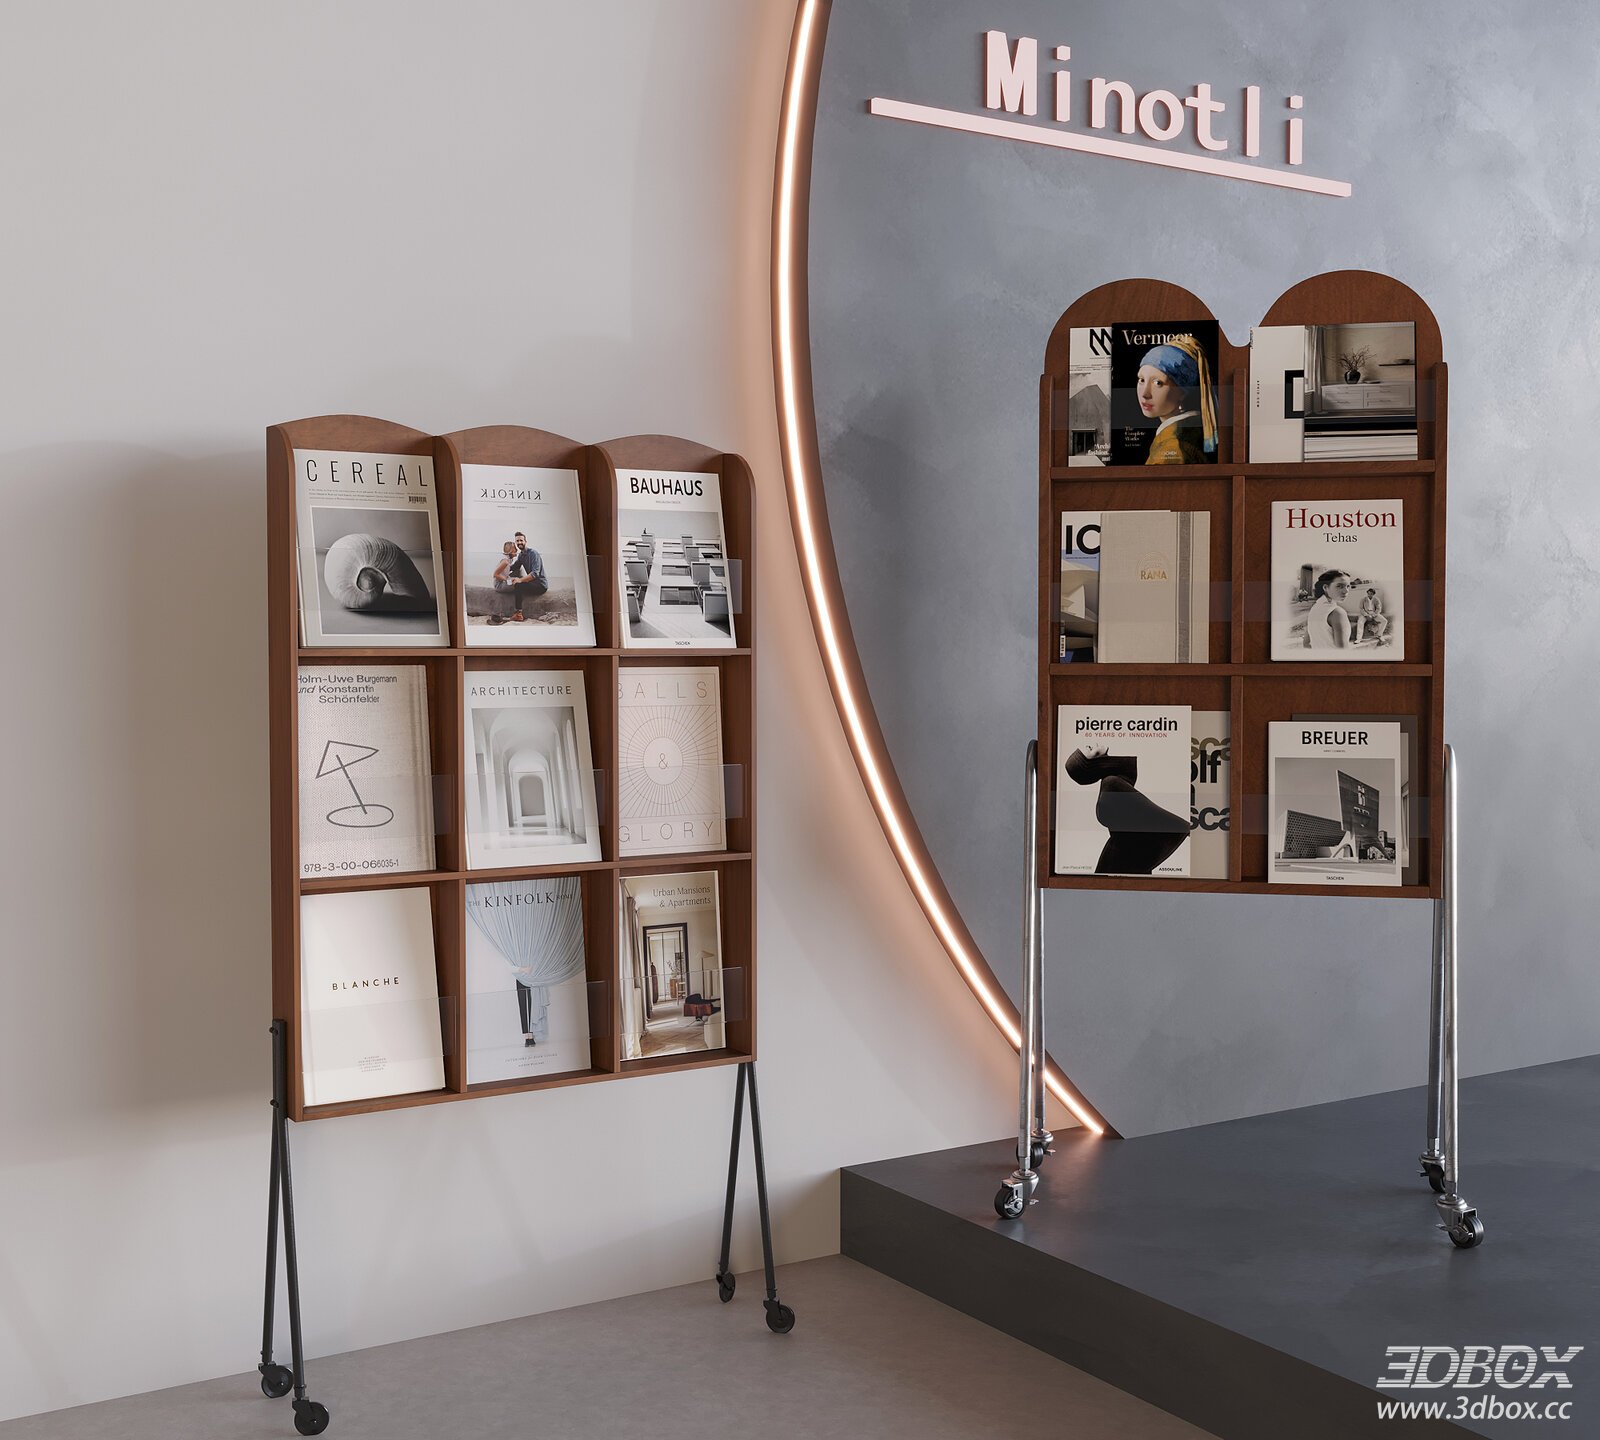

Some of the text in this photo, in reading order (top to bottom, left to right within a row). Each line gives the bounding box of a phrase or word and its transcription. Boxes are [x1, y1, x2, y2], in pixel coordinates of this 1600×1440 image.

[983, 29, 1303, 165] Minotli
[1122, 329, 1193, 345] Vermeer
[306, 459, 428, 487] CEREAL
[630, 477, 703, 496] BAUHAUS
[1285, 508, 1397, 529] Houston
[1323, 532, 1358, 543] Tehas
[318, 695, 380, 703] Schönfelder
[471, 686, 572, 696] ARCHITECTURE
[1075, 717, 1178, 734] pierre cardin
[1302, 731, 1368, 745] BREUER
[659, 753, 669, 769] &
[618, 821, 714, 843] GLORY
[652, 886, 711, 897] Urban Mansions
[484, 892, 554, 908] KINFOLK
[660, 898, 711, 909] & Apartments
[332, 977, 400, 991] BLANCHE
